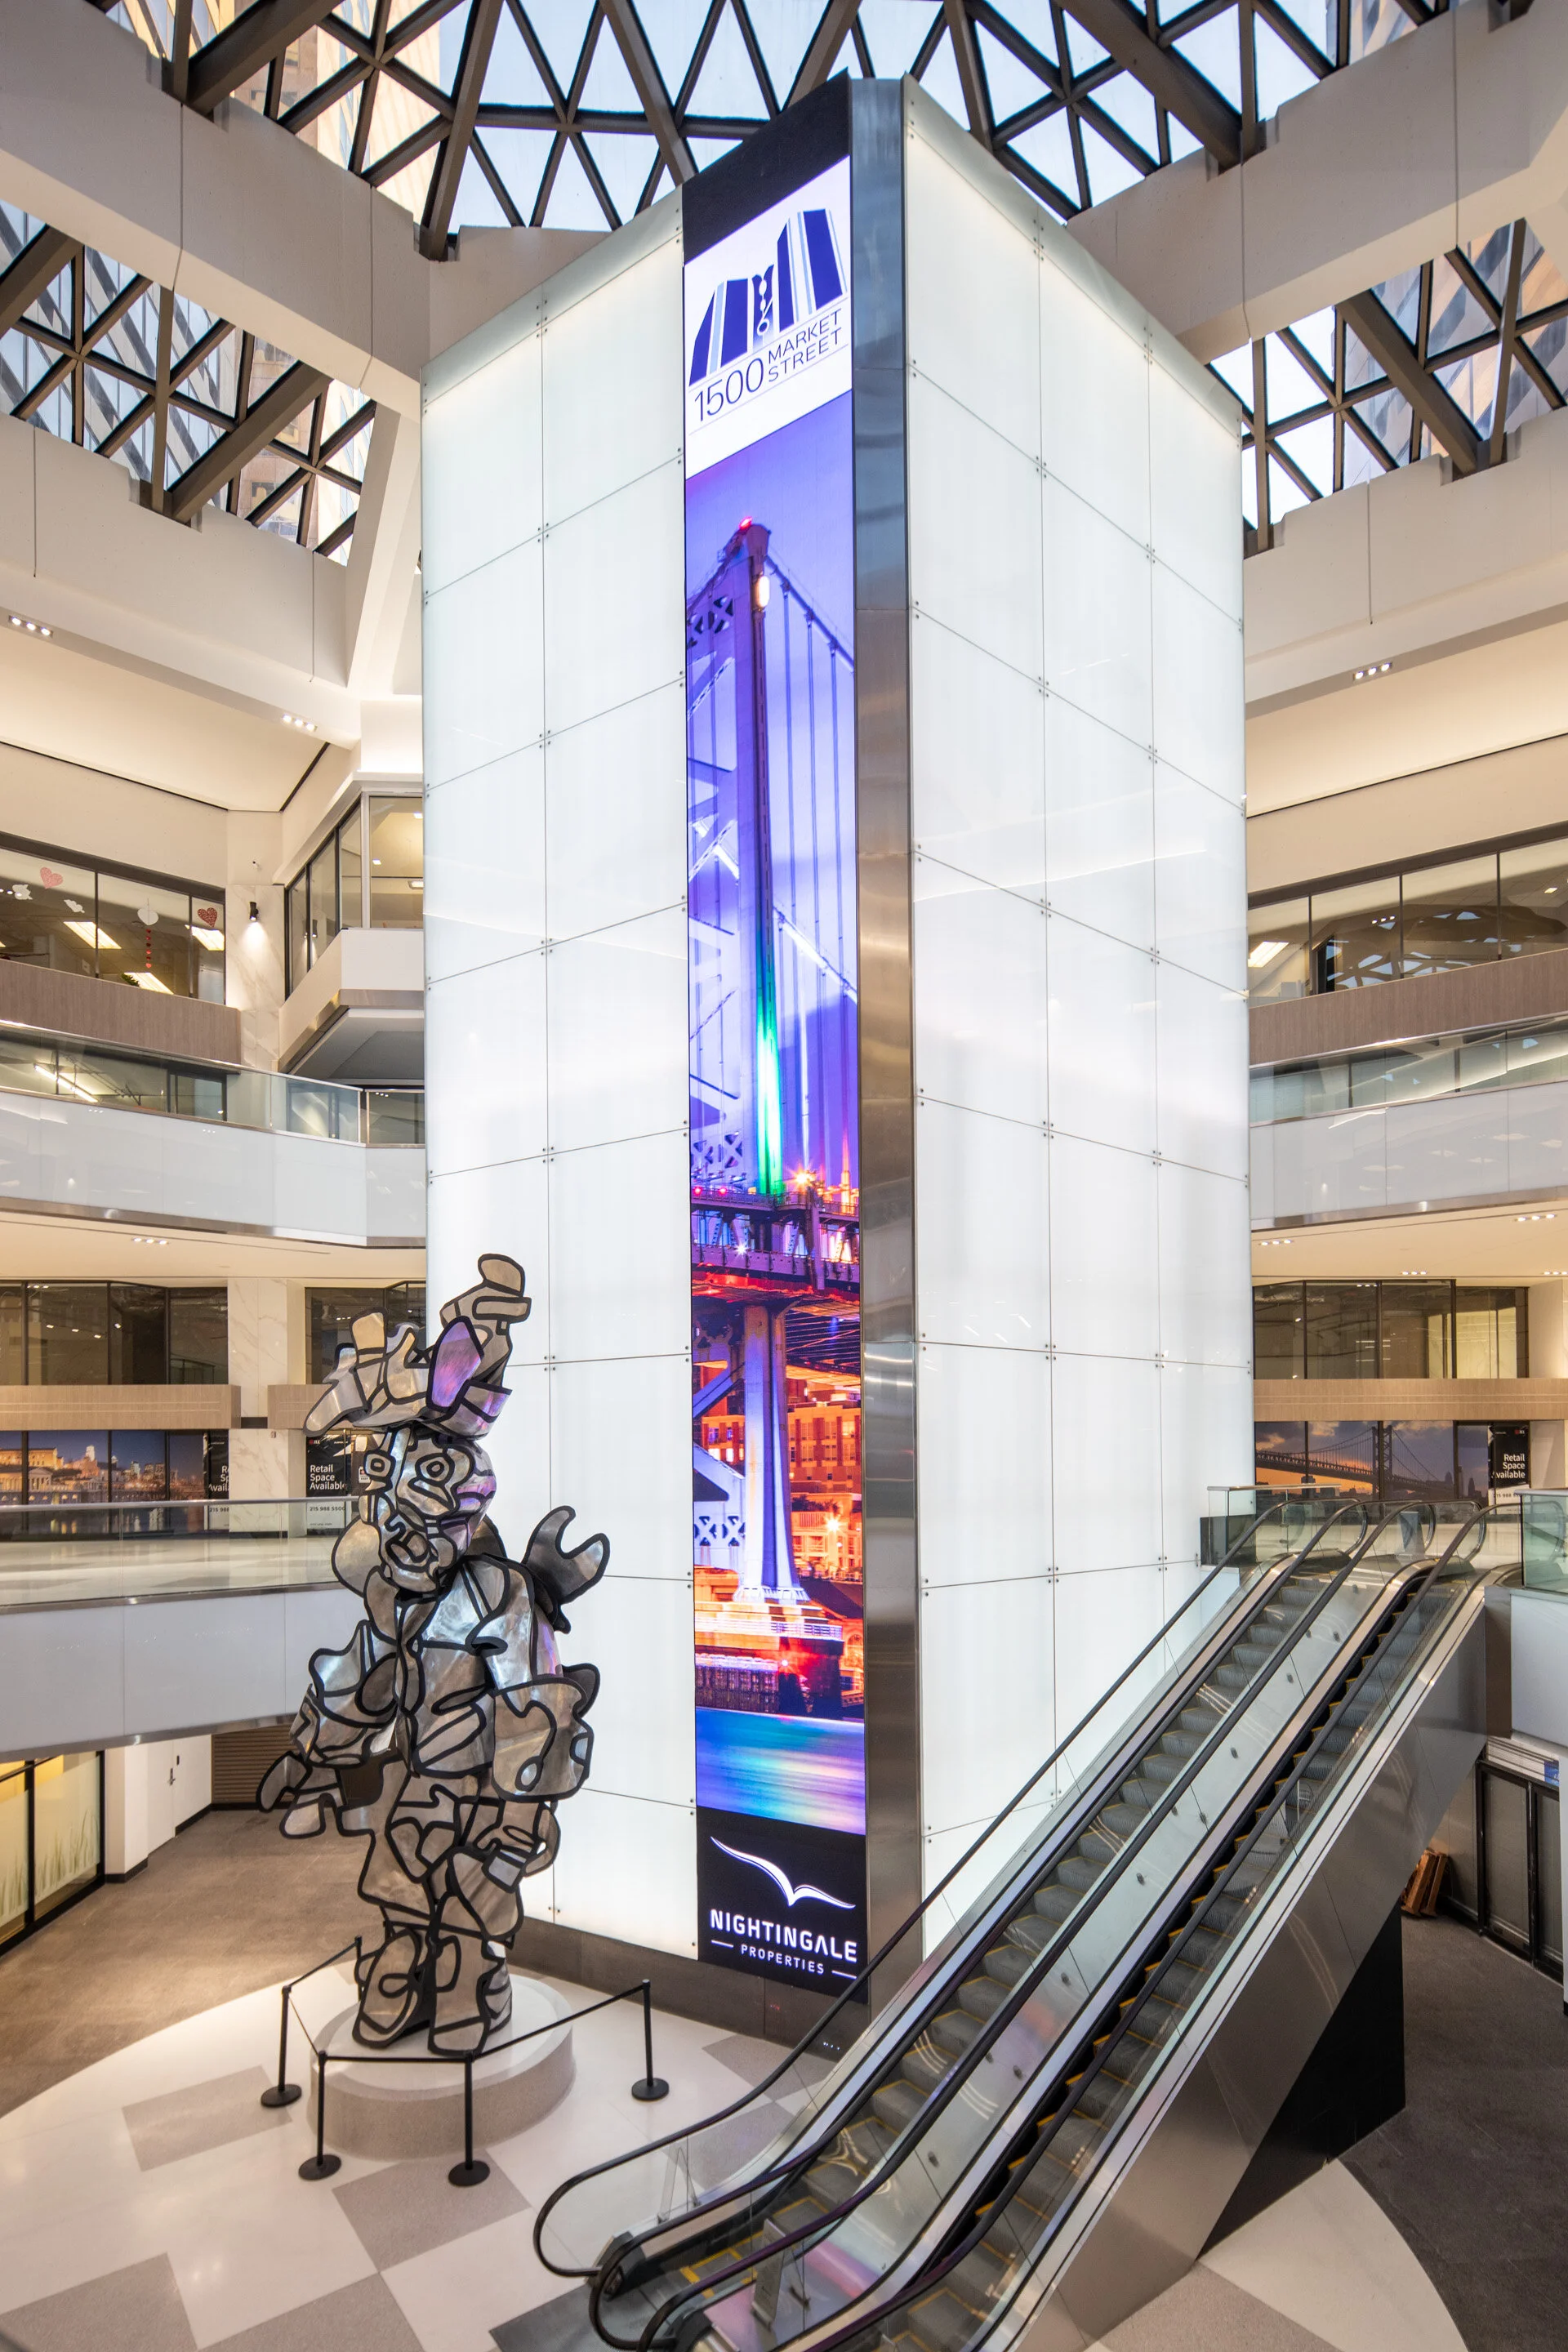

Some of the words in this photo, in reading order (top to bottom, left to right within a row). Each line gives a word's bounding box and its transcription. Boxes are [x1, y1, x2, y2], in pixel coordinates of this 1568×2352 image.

[768, 308, 842, 364] MARKET
[768, 327, 842, 382] STREET
[694, 358, 764, 421] 1500
[310, 1464, 333, 1472] Retail
[1503, 1454, 1525, 1462] Retail
[1503, 1462, 1525, 1471] Space
[310, 1473, 335, 1483] Space
[710, 1909, 858, 1963] NIGHTINGALE
[741, 1944, 825, 1974] PROPERTIES
